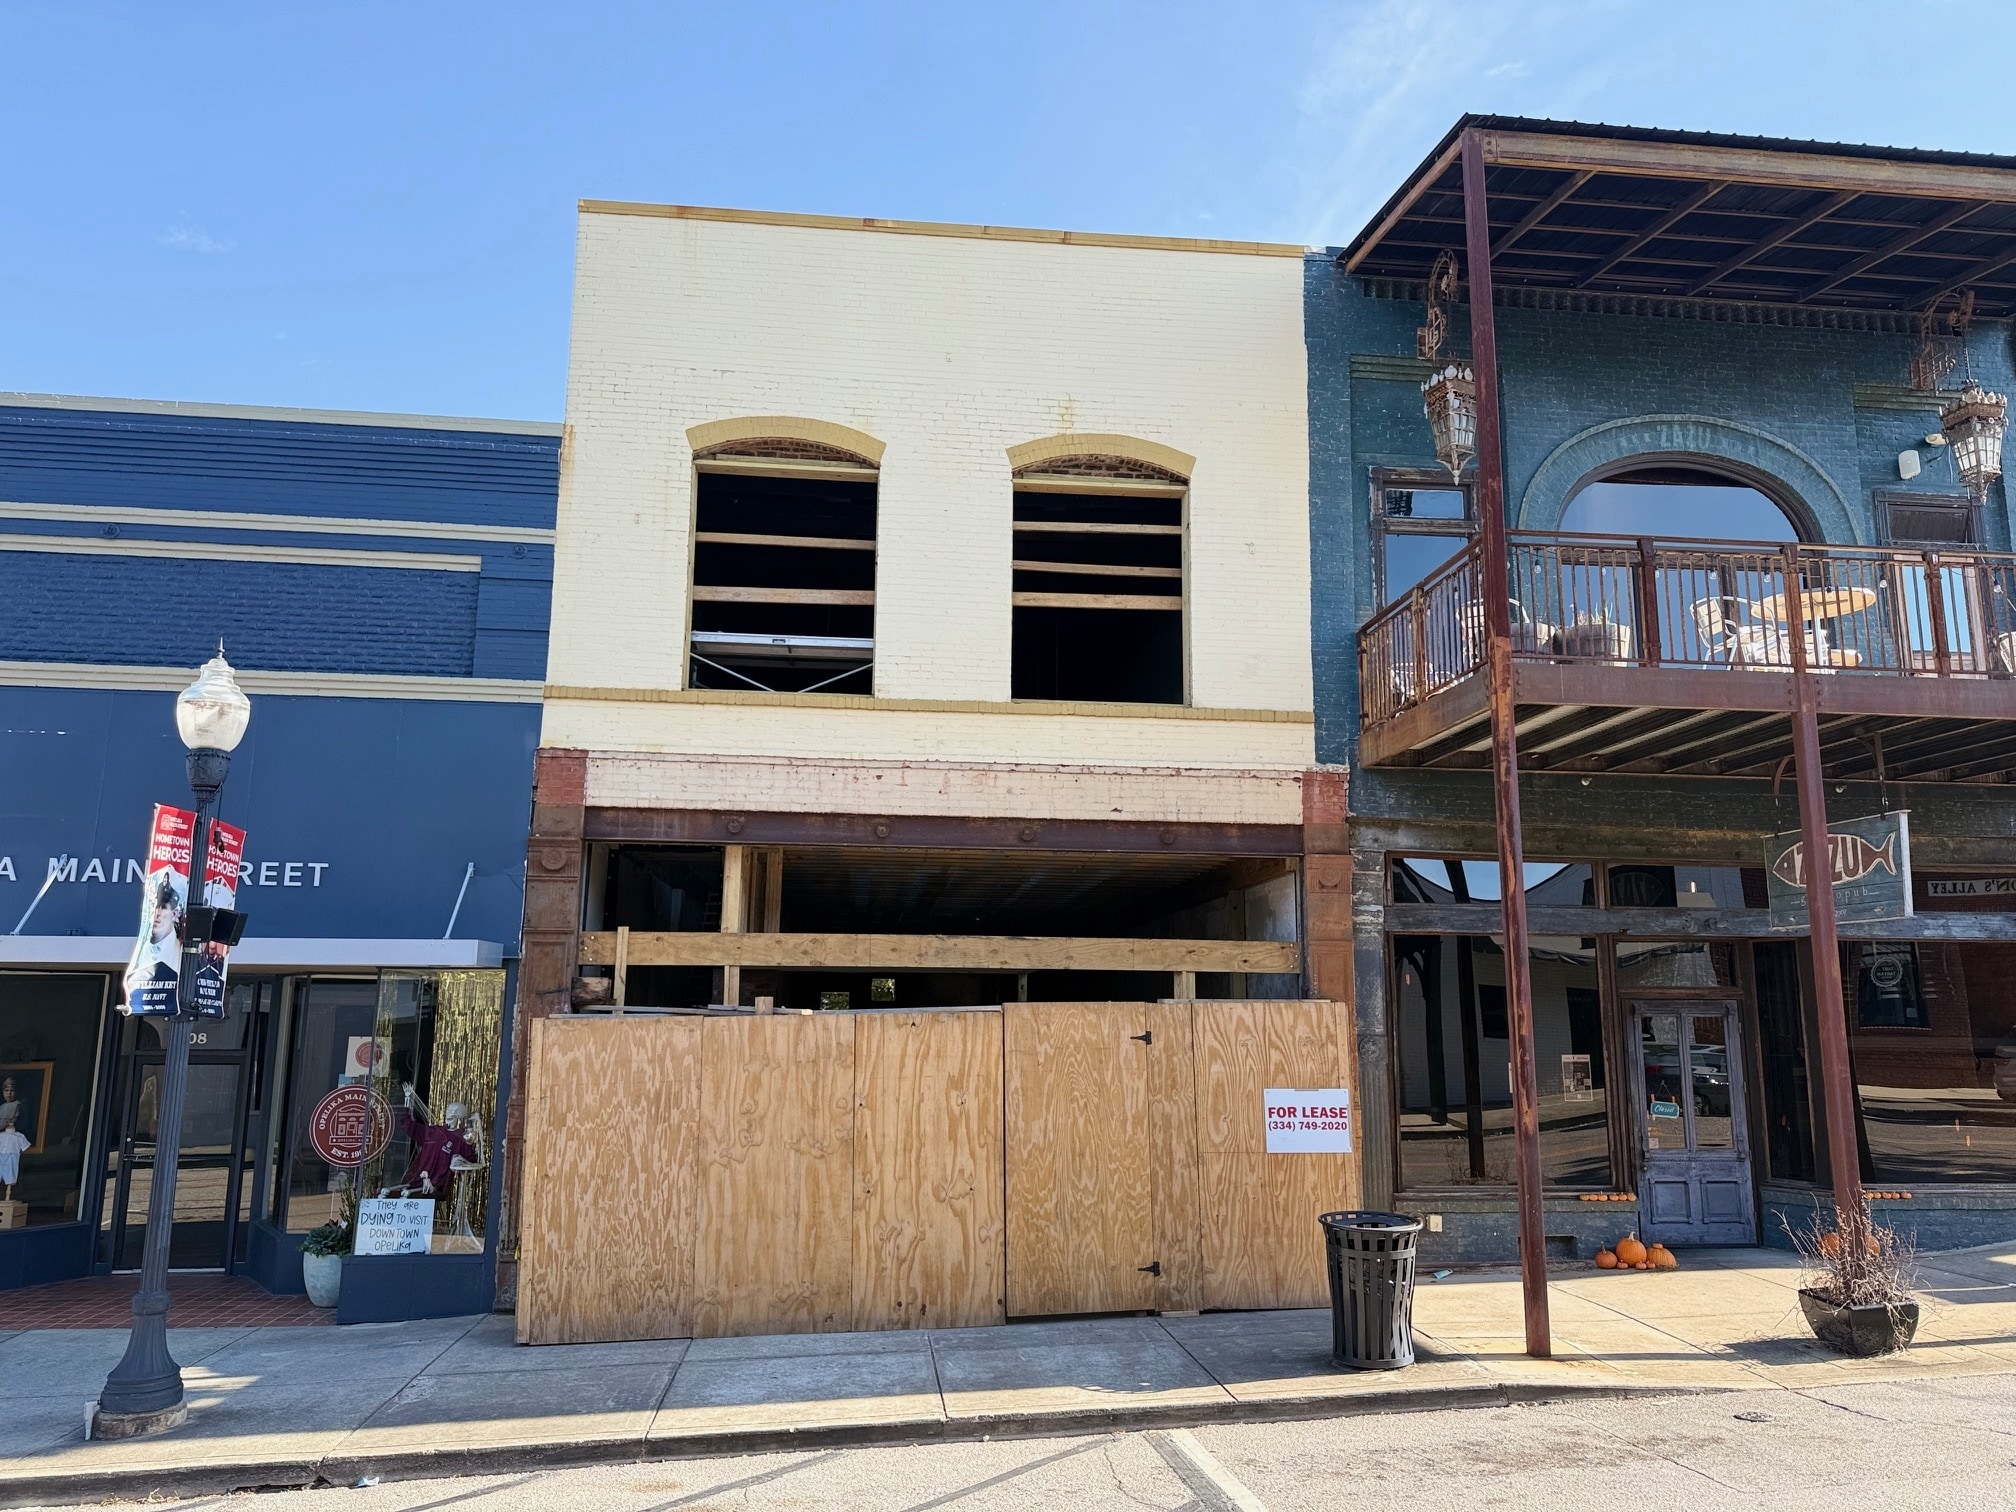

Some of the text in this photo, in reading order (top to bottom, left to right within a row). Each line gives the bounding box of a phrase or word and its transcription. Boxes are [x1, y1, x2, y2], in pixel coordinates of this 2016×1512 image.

[155, 833, 190, 847] HOMETOWN
[153, 845, 190, 863] HEROES
[46, 857, 146, 883] MAIN
[206, 856, 238, 878] HEROES
[319, 1097, 344, 1130] OPELIKA
[1267, 1106, 1348, 1119] FOR LEASE
[1268, 1120, 1348, 1131] (334) 749-2020
[331, 1147, 349, 1159] EST.
